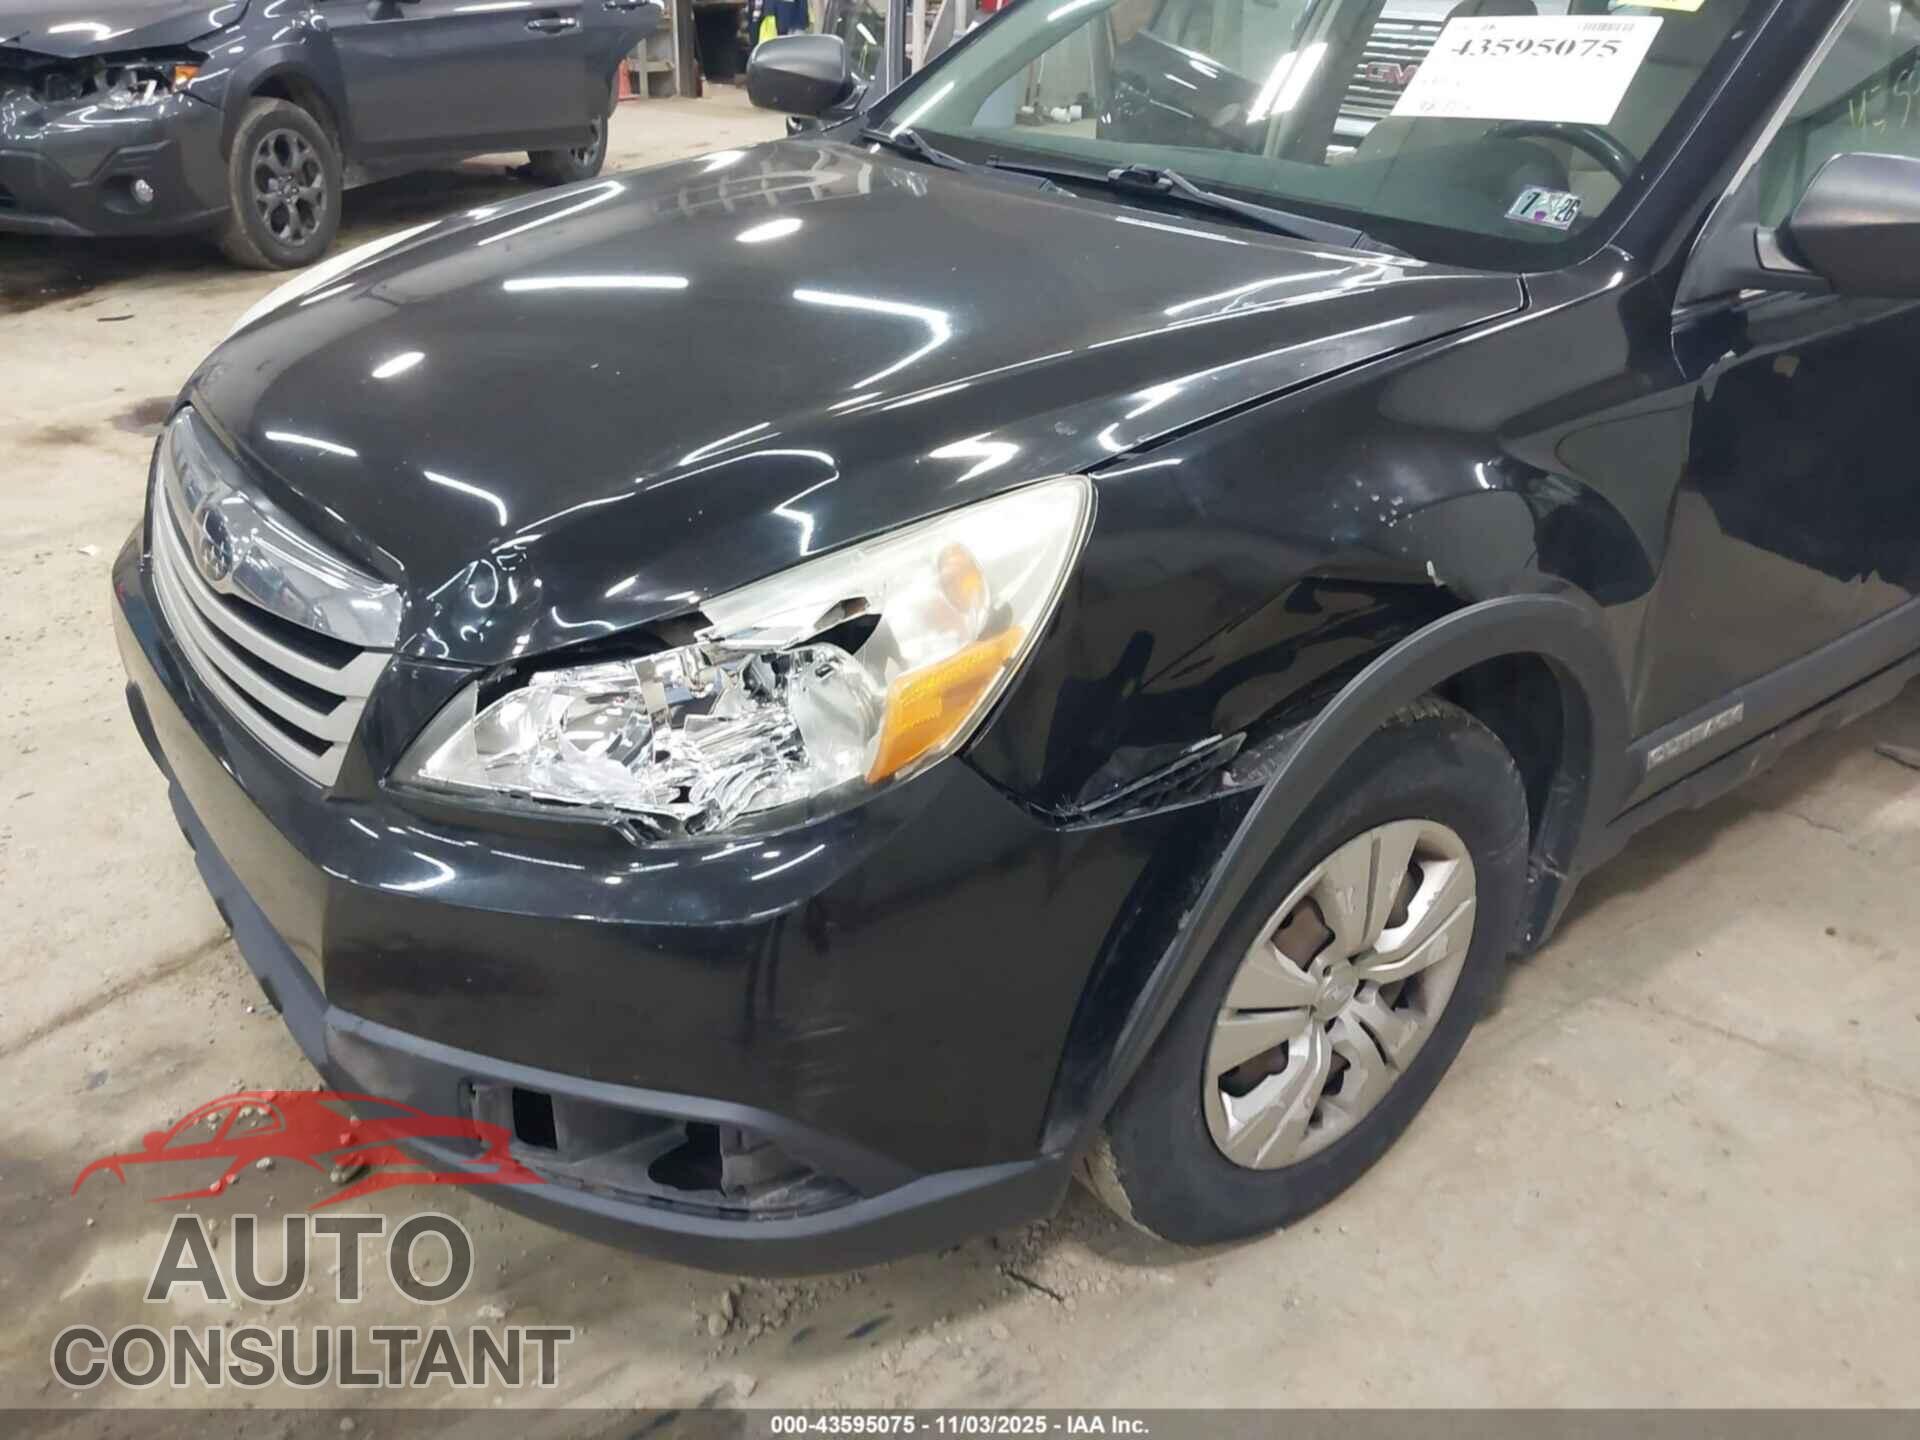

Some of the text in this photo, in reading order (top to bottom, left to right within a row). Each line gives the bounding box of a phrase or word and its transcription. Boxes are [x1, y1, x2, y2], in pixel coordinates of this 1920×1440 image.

[1451, 38, 1623, 57] 43595075
[1366, 61, 1418, 86] GM
[1554, 197, 1581, 222] 26
